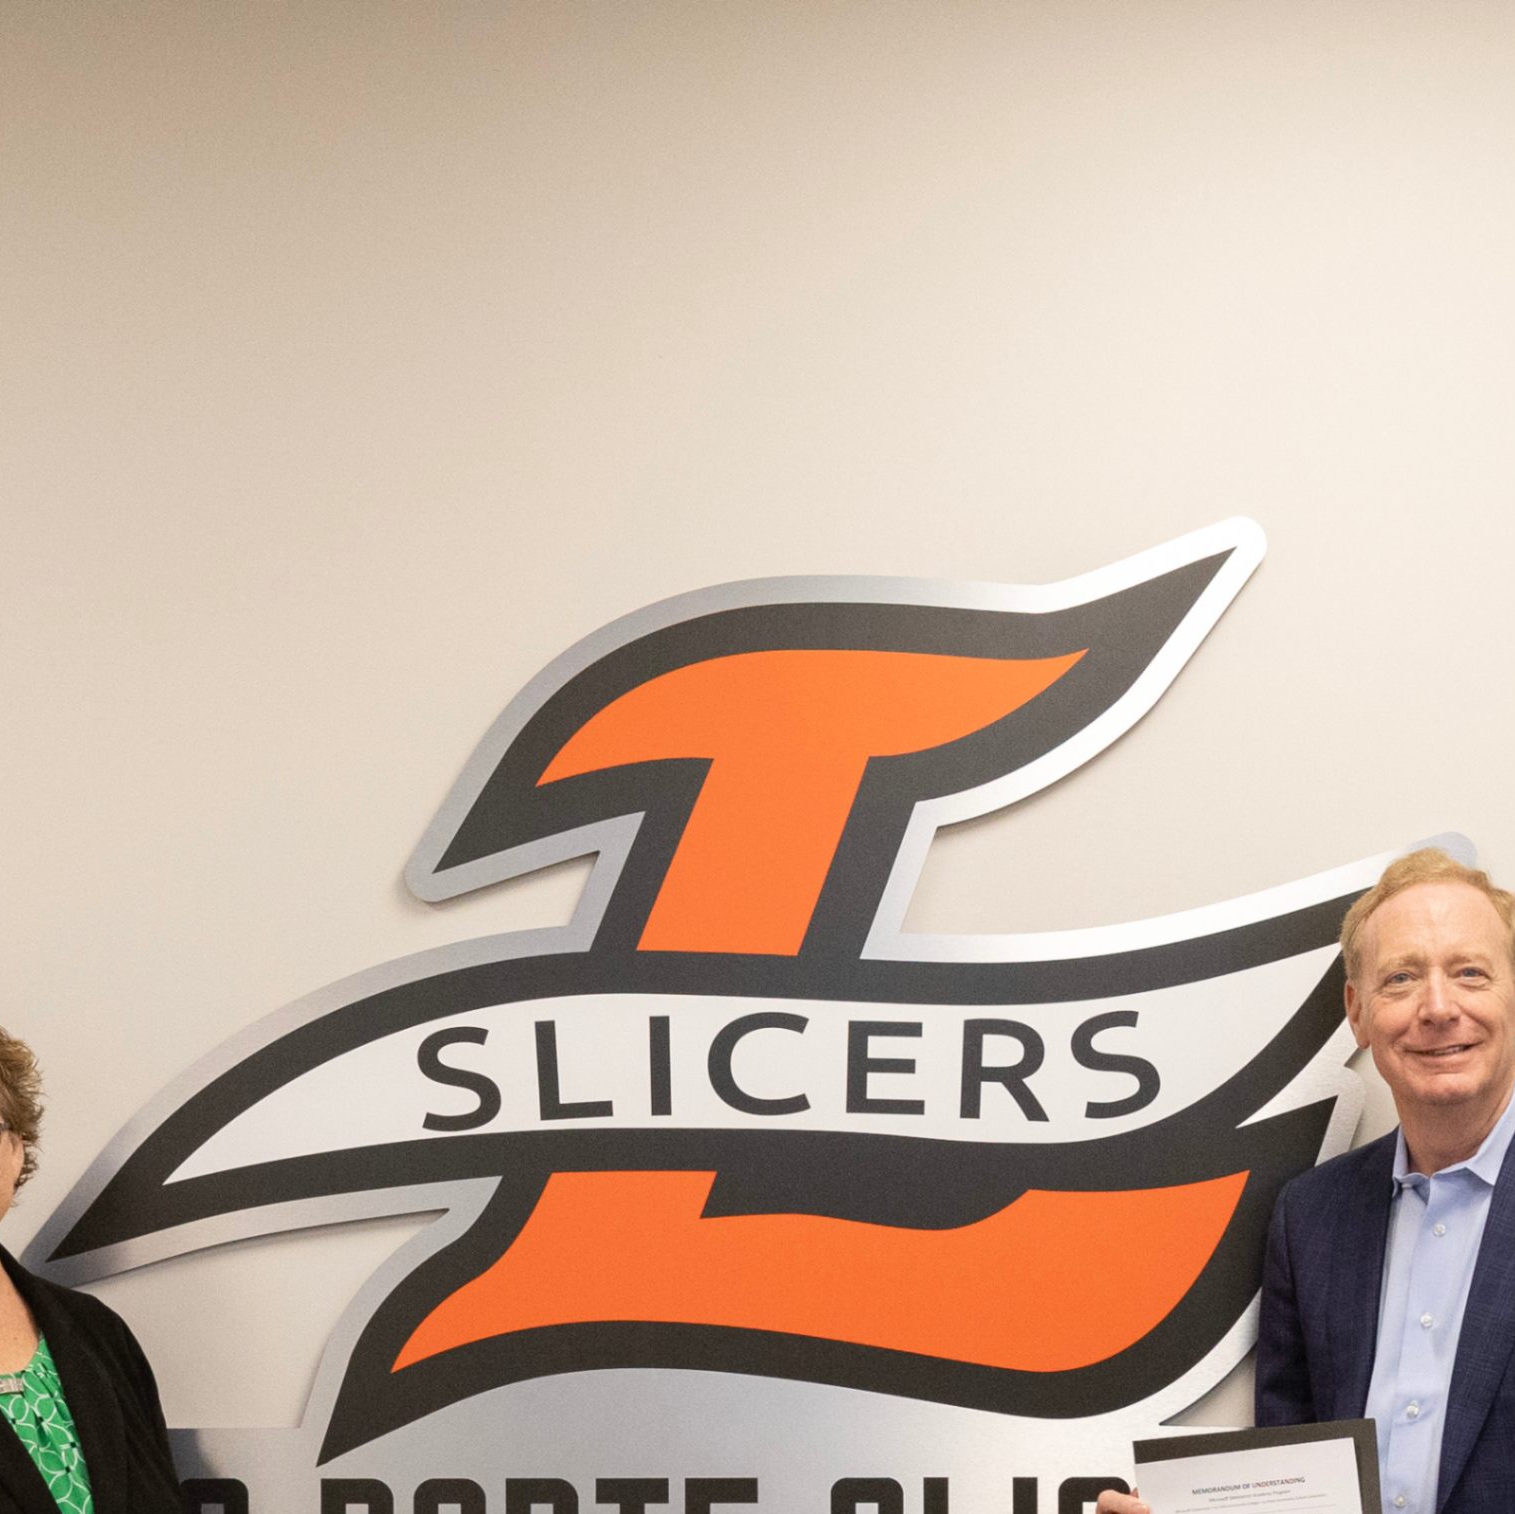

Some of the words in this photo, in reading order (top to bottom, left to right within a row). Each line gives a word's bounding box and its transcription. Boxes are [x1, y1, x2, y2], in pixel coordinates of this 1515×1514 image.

[416, 1010, 1162, 1132] SLICERS
[1191, 1484, 1241, 1495] MEMORANDUM
[1242, 1482, 1251, 1490] OF
[1251, 1476, 1306, 1489] UNDERSTANDING
